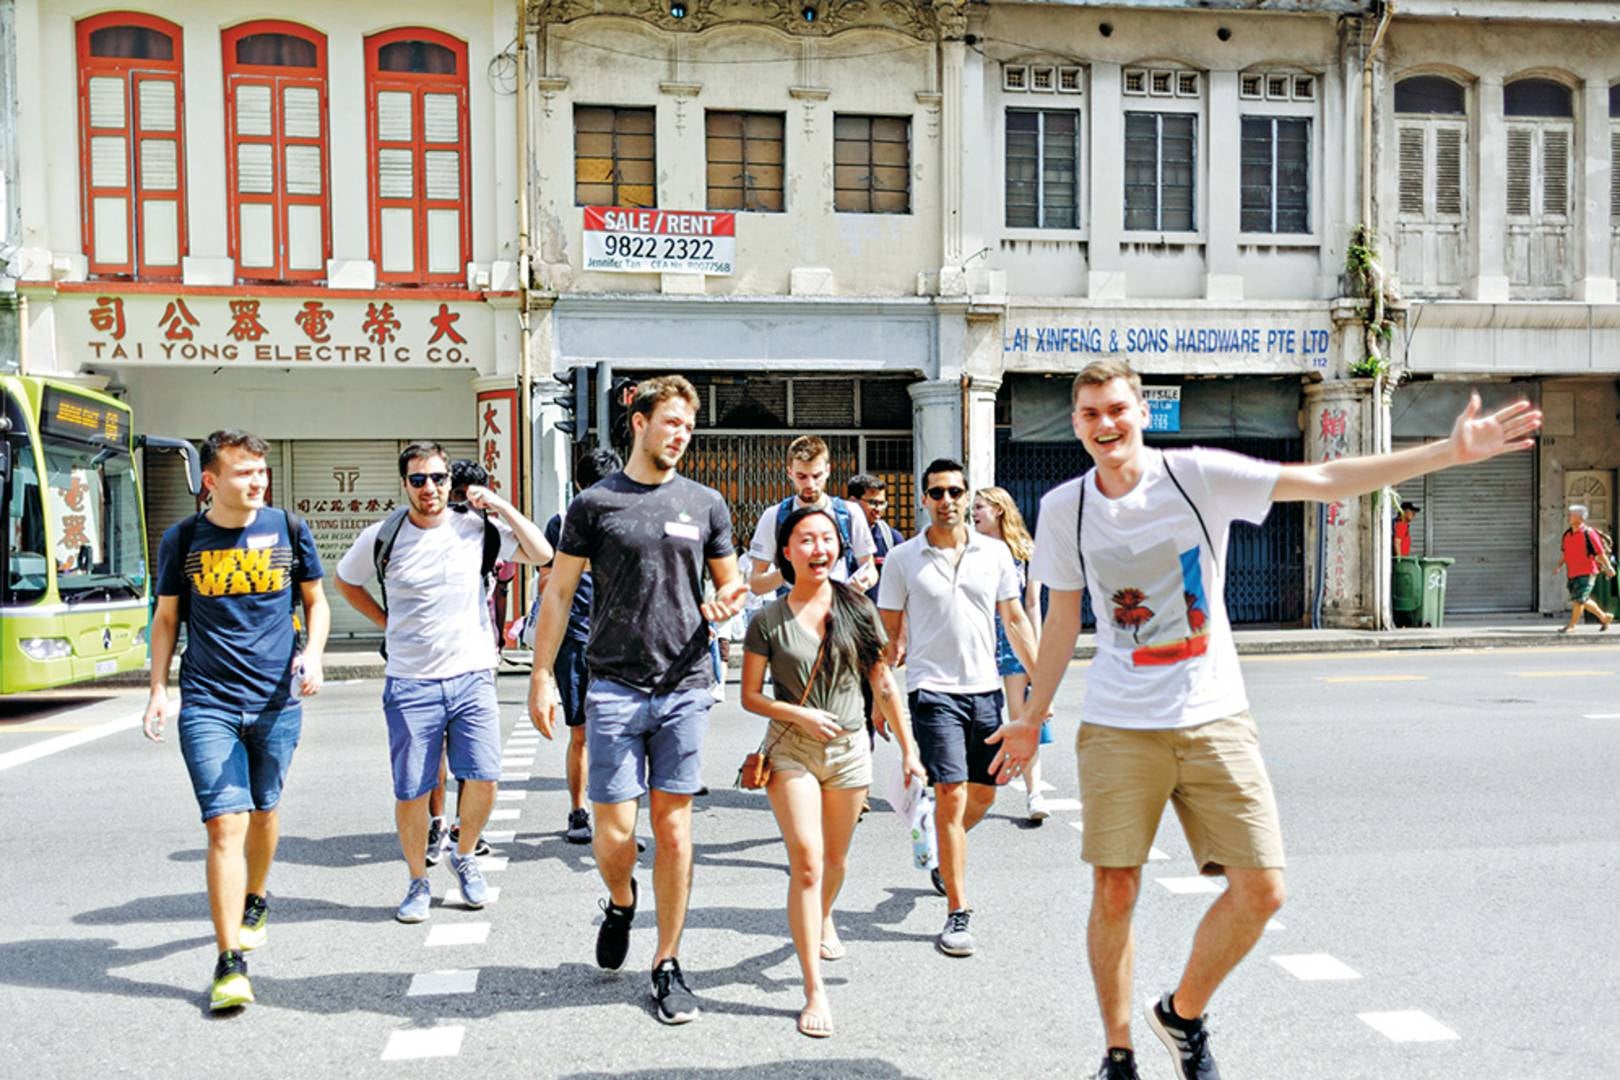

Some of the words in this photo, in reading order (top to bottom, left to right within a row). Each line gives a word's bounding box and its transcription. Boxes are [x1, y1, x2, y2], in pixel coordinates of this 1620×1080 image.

[604, 210, 650, 231] SALE
[653, 211, 664, 233] /
[666, 214, 716, 235] RENT
[605, 235, 657, 258] 9822
[663, 238, 714, 260] 2322
[587, 257, 623, 267] Jennifer
[88, 342, 143, 359] TAI
[160, 343, 238, 360] YONG
[255, 345, 410, 362] ELECTRIC
[426, 347, 470, 363] CO.
[1036, 327, 1101, 353] XINFENG
[1108, 329, 1118, 353] &
[1127, 328, 1169, 353] SONS
[1175, 328, 1260, 353] HARDWARE
[1267, 329, 1296, 353] PTE
[1302, 330, 1329, 354] LTD
[1313, 358, 1327, 367] 112
[200, 548, 273, 574] NEW
